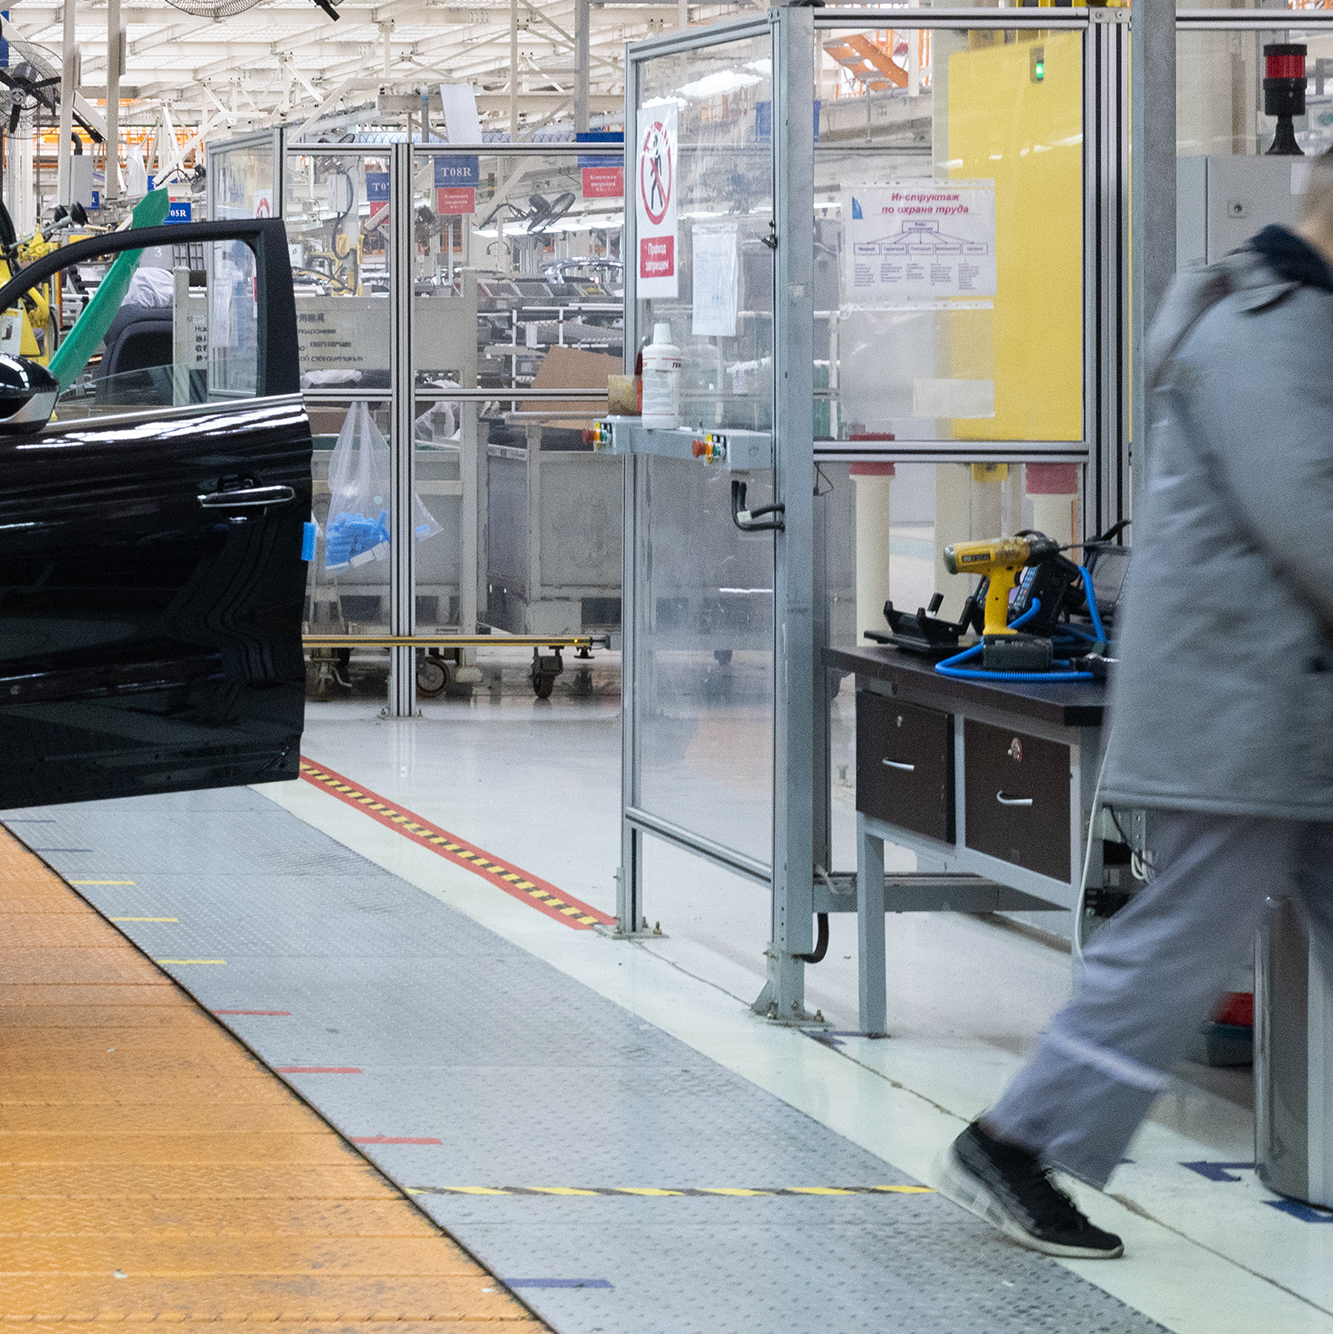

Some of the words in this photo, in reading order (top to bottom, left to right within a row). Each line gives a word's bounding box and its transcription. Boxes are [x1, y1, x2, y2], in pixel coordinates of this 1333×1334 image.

[440, 167, 472, 177] T08R
[168, 209, 187, 217] 05R
[935, 205, 969, 215] труда
